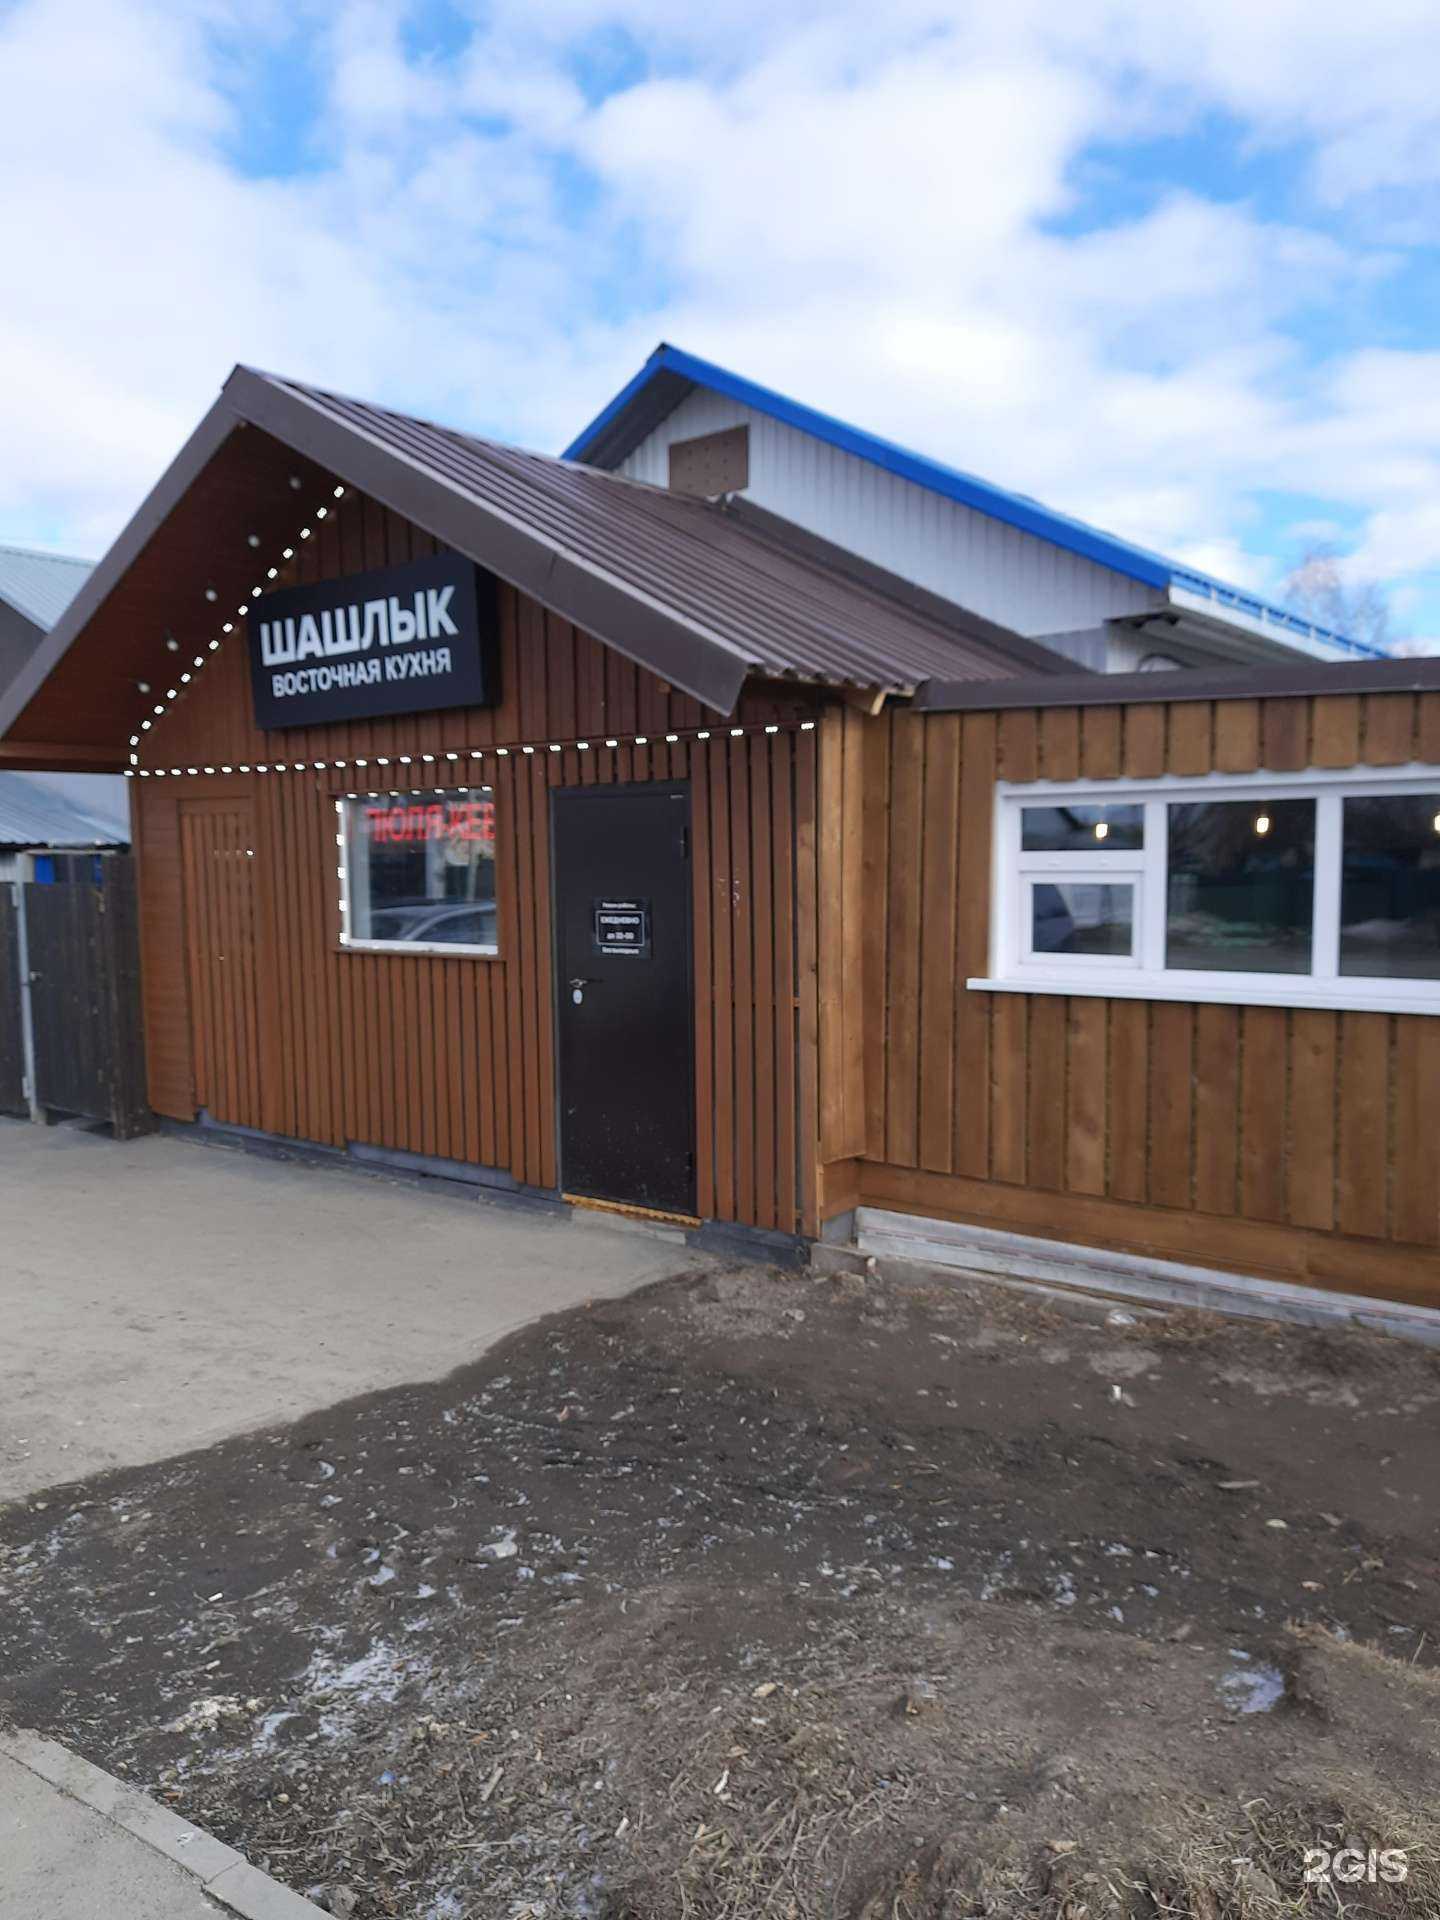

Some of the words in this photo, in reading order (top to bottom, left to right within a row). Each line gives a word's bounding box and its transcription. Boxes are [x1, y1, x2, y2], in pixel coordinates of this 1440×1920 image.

[260, 585, 459, 667] ШАШЛЫК
[272, 658, 382, 698] ВОСТОЧНАЯ
[384, 647, 452, 681] КУХНЯ
